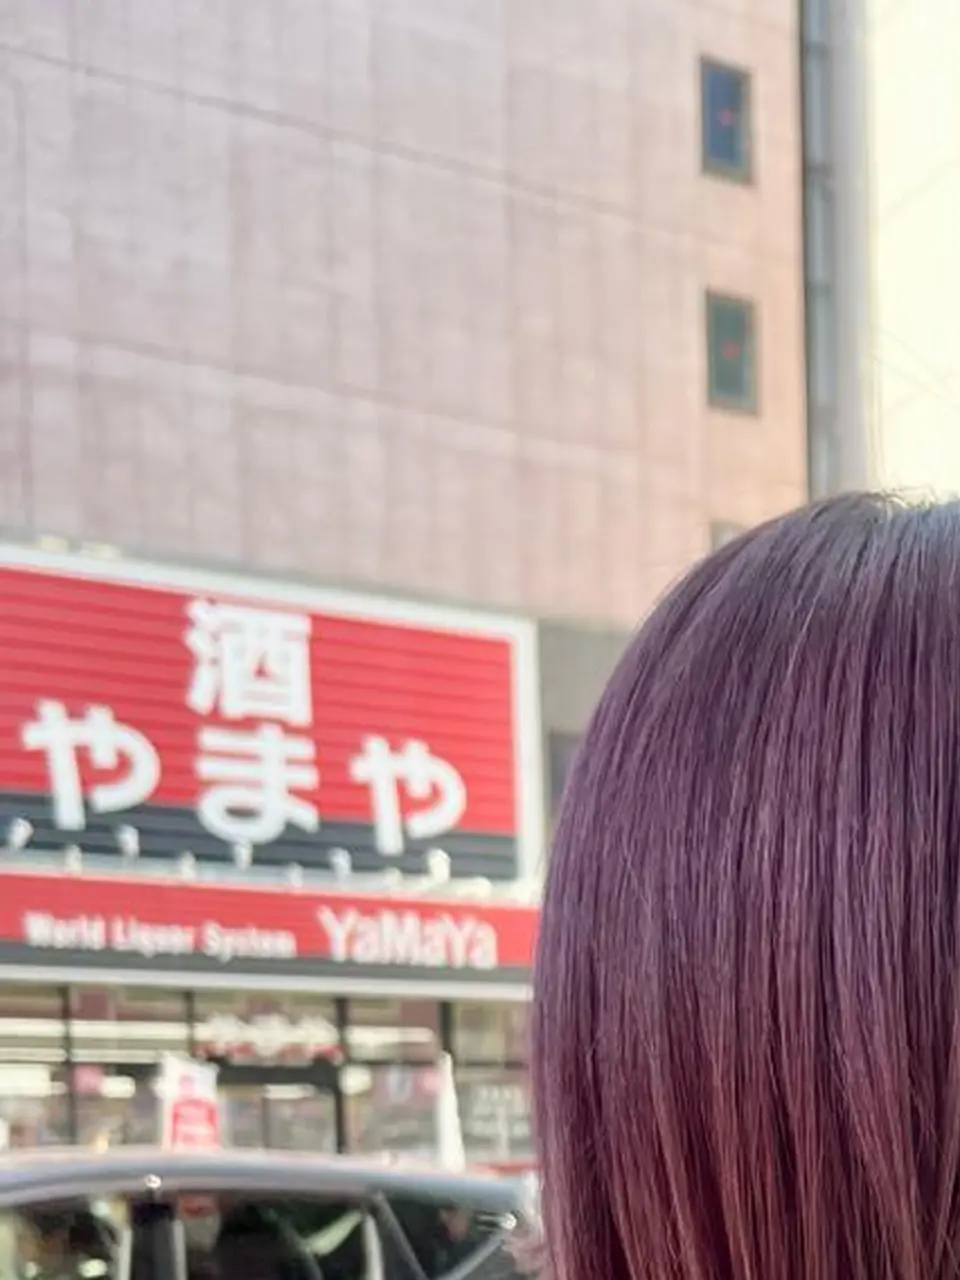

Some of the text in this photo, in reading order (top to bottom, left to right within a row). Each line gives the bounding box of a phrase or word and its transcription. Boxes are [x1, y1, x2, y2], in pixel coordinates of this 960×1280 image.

[185, 598, 312, 726] 酒
[21, 699, 467, 856] やまや
[23, 911, 297, 963] World Liquor System
[317, 905, 499, 970] YaMaYa
